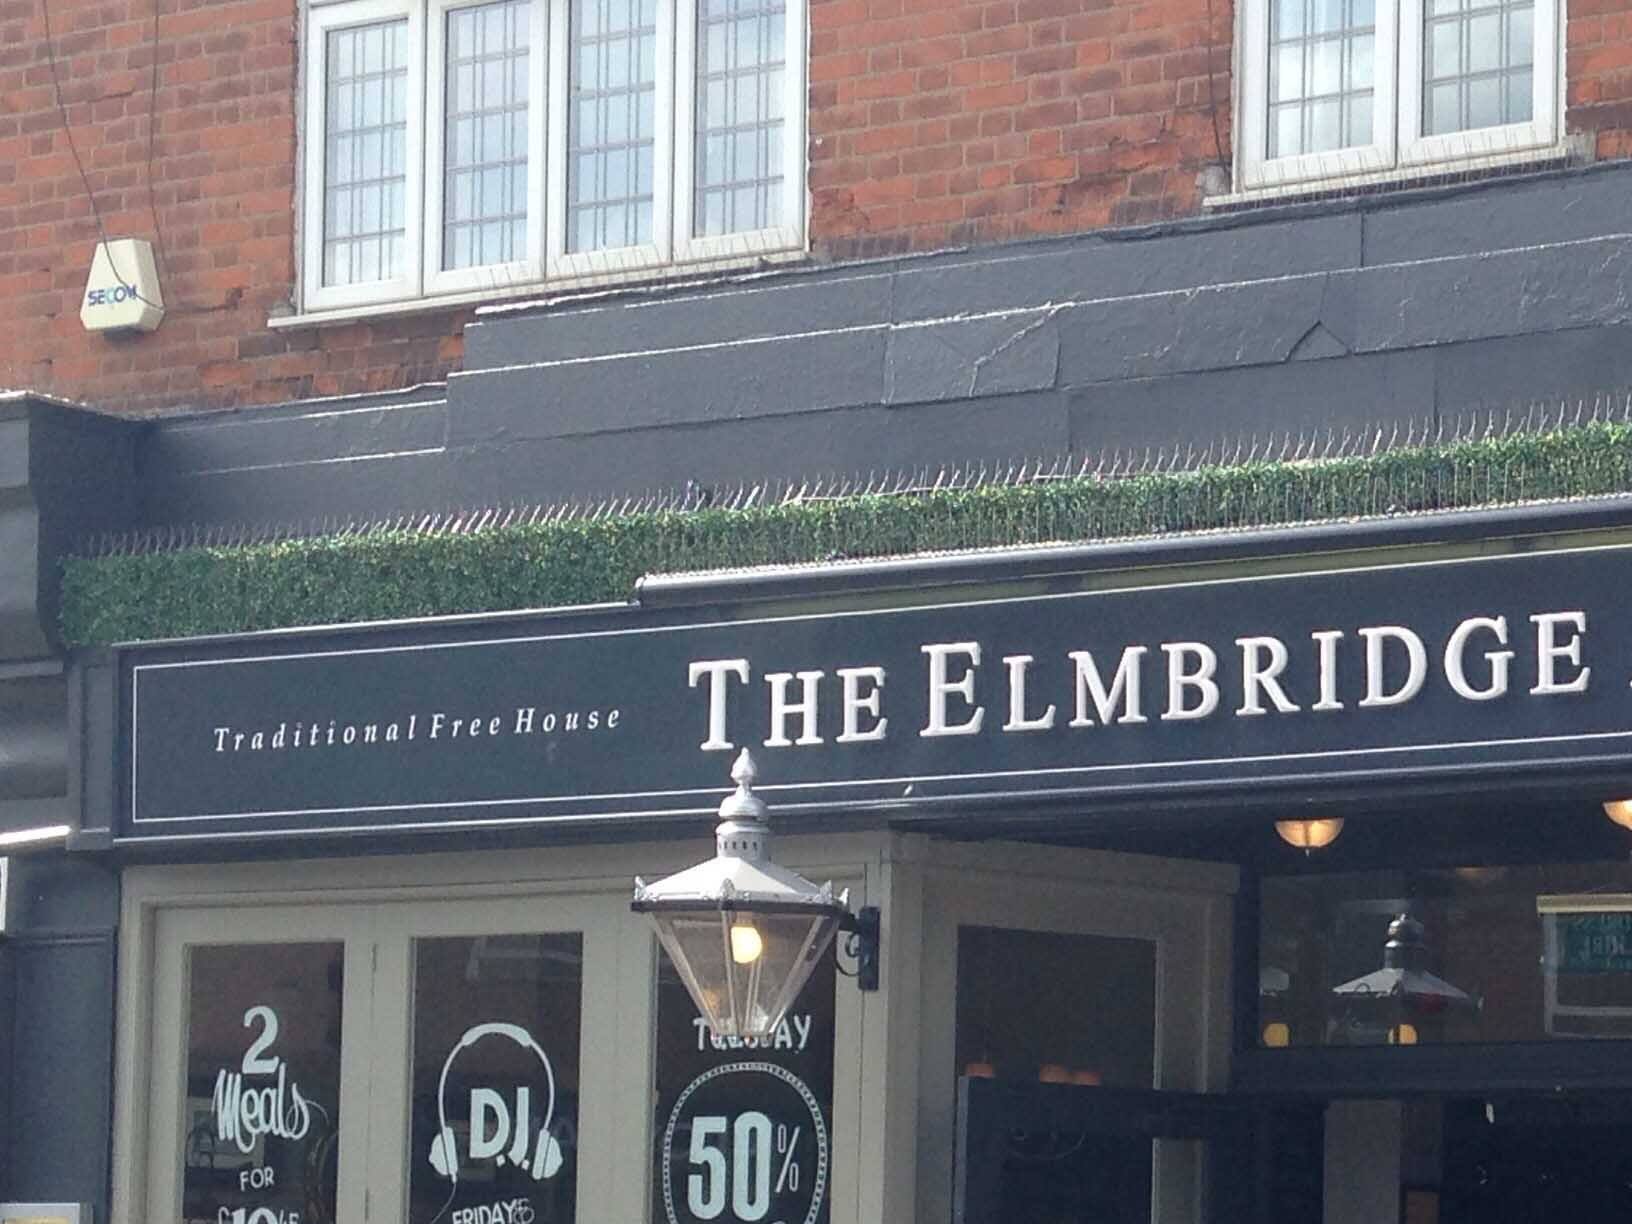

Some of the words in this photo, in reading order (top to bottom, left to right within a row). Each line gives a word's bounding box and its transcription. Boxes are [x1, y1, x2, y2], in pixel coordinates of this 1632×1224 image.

[88, 284, 136, 307] SECOM
[687, 658, 888, 752] THE
[919, 609, 1592, 738] ELMBRIDGE
[212, 715, 418, 753] Traditional
[428, 712, 502, 740] Free
[513, 706, 622, 736] House
[242, 1004, 279, 1074] 2
[211, 1062, 328, 1153] Meals
[239, 1166, 275, 1192] FOR
[687, 1110, 801, 1222] 50%
